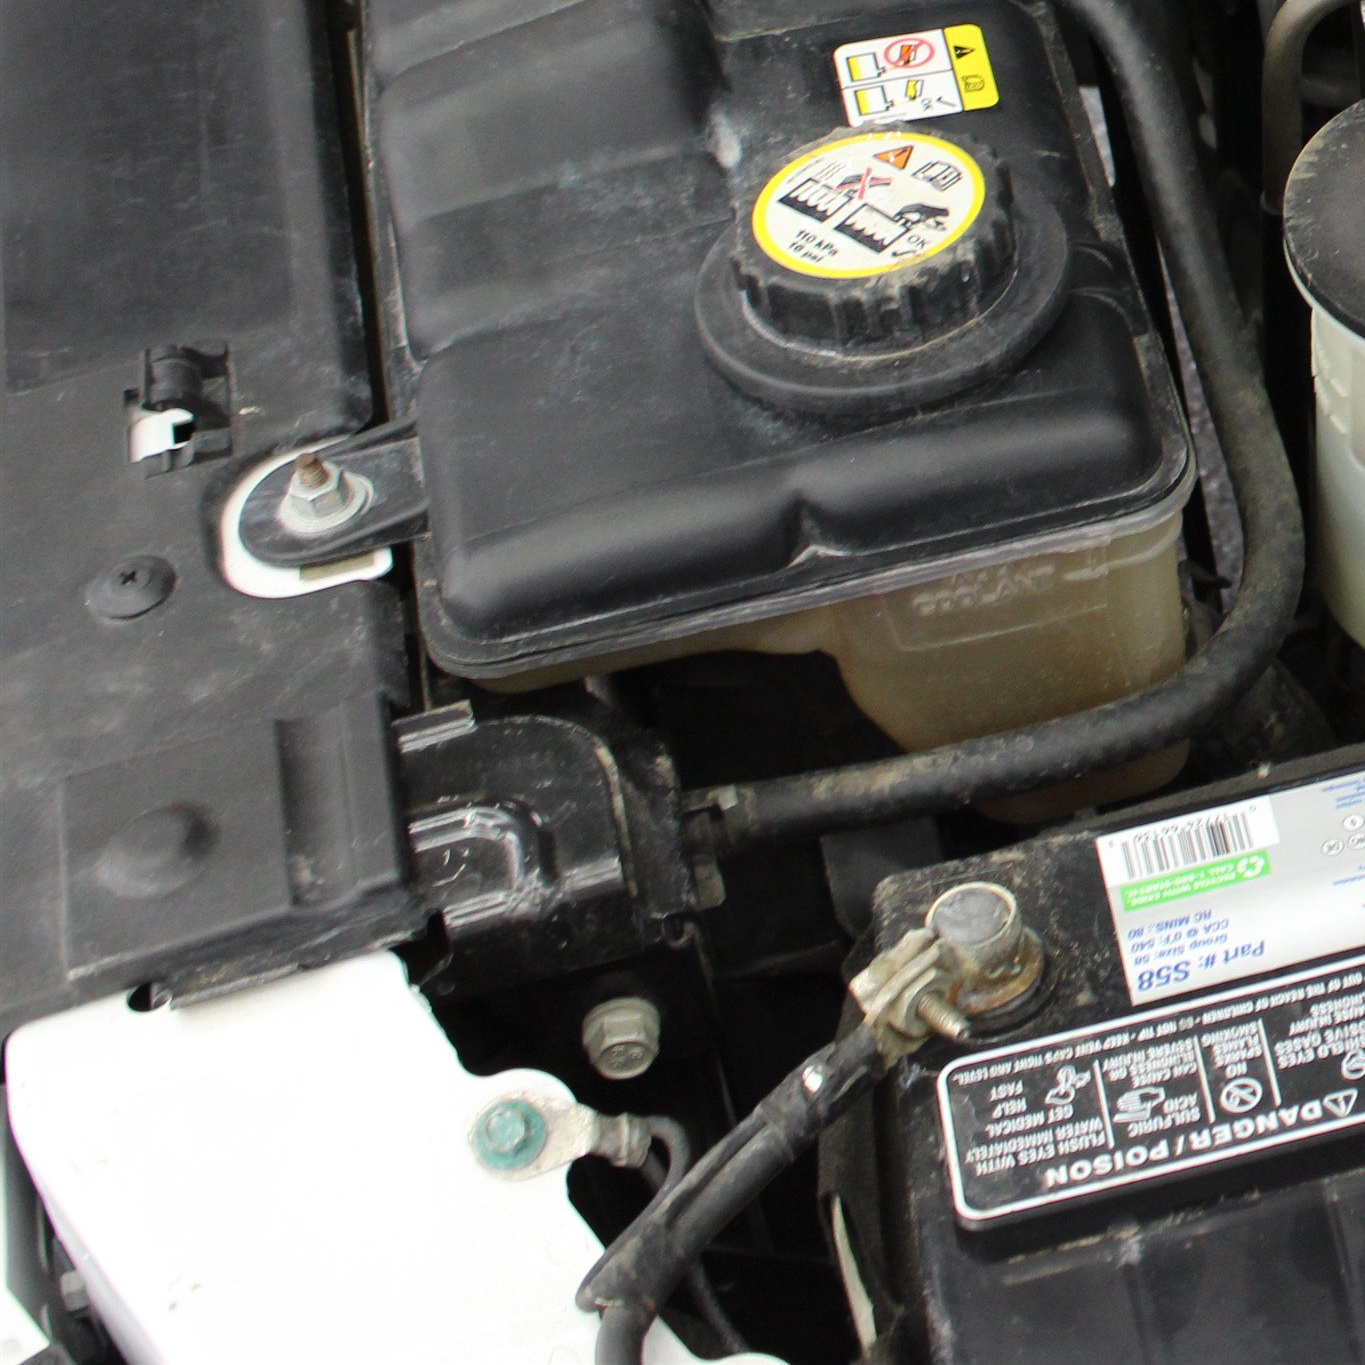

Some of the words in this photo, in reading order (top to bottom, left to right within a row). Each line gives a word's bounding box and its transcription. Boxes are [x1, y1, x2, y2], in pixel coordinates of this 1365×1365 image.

[795, 228, 816, 244] 110
[815, 237, 840, 257] kPa
[906, 233, 933, 249] OK
[800, 248, 825, 264] psi
[1194, 909, 1212, 922] RC
[1186, 928, 1199, 938] @
[1203, 919, 1229, 934] CCA
[1131, 939, 1155, 953] 540
[1189, 934, 1227, 950] Group
[1223, 941, 1264, 964] Part
[1196, 953, 1218, 971] #:
[1138, 961, 1190, 991] S58
[1327, 978, 1341, 993] OF
[1342, 972, 1363, 989] OUT
[1266, 988, 1305, 1007] REACH
[1302, 982, 1326, 998] THE
[1202, 1001, 1254, 1025] CHILDREN
[1251, 997, 1270, 1012] OF
[1137, 1026, 1155, 1041] TIP
[1156, 1021, 1177, 1037] NOT
[1289, 1010, 1332, 1036] INJURY
[1099, 1033, 1130, 1050] KEEP
[1201, 1022, 1261, 1047] SMOKING
[1274, 1031, 1321, 1057] GASES
[1044, 1047, 1073, 1064] CAPS
[1075, 1040, 1102, 1058] VENT
[1146, 1038, 1197, 1063] SEVERE
[1213, 1034, 1261, 1057] FLAMES
[1214, 1043, 1262, 1067] SPARKS
[1010, 1055, 1044, 1073] TIGHT
[1102, 1050, 1148, 1072] INJURY
[1129, 1048, 1194, 1076] BLINDNESS
[1276, 1046, 1315, 1069] EYES
[989, 1061, 1012, 1078] AND
[1107, 1064, 1128, 1081] OR
[1132, 1066, 1171, 1088] CAUSE
[1172, 1059, 1201, 1078] CAN
[1225, 1061, 1247, 1078] NO
[990, 1080, 1023, 1101] FAST
[992, 1097, 1027, 1119] HELP
[1047, 1102, 1073, 1124] GET
[1159, 1093, 1197, 1114] ACID
[985, 1111, 1045, 1138] MEDICAL
[1055, 1117, 1103, 1140] WATER
[1128, 1106, 1200, 1137] SULFURIC
[1189, 1100, 1322, 1150] DANGER
[965, 1129, 1053, 1163] IMMEDIATELY
[1058, 1131, 1106, 1155] FLUSH
[1018, 1143, 1055, 1165] EYES
[1045, 1140, 1169, 1188] POISON
[976, 1154, 1015, 1176] WITH
